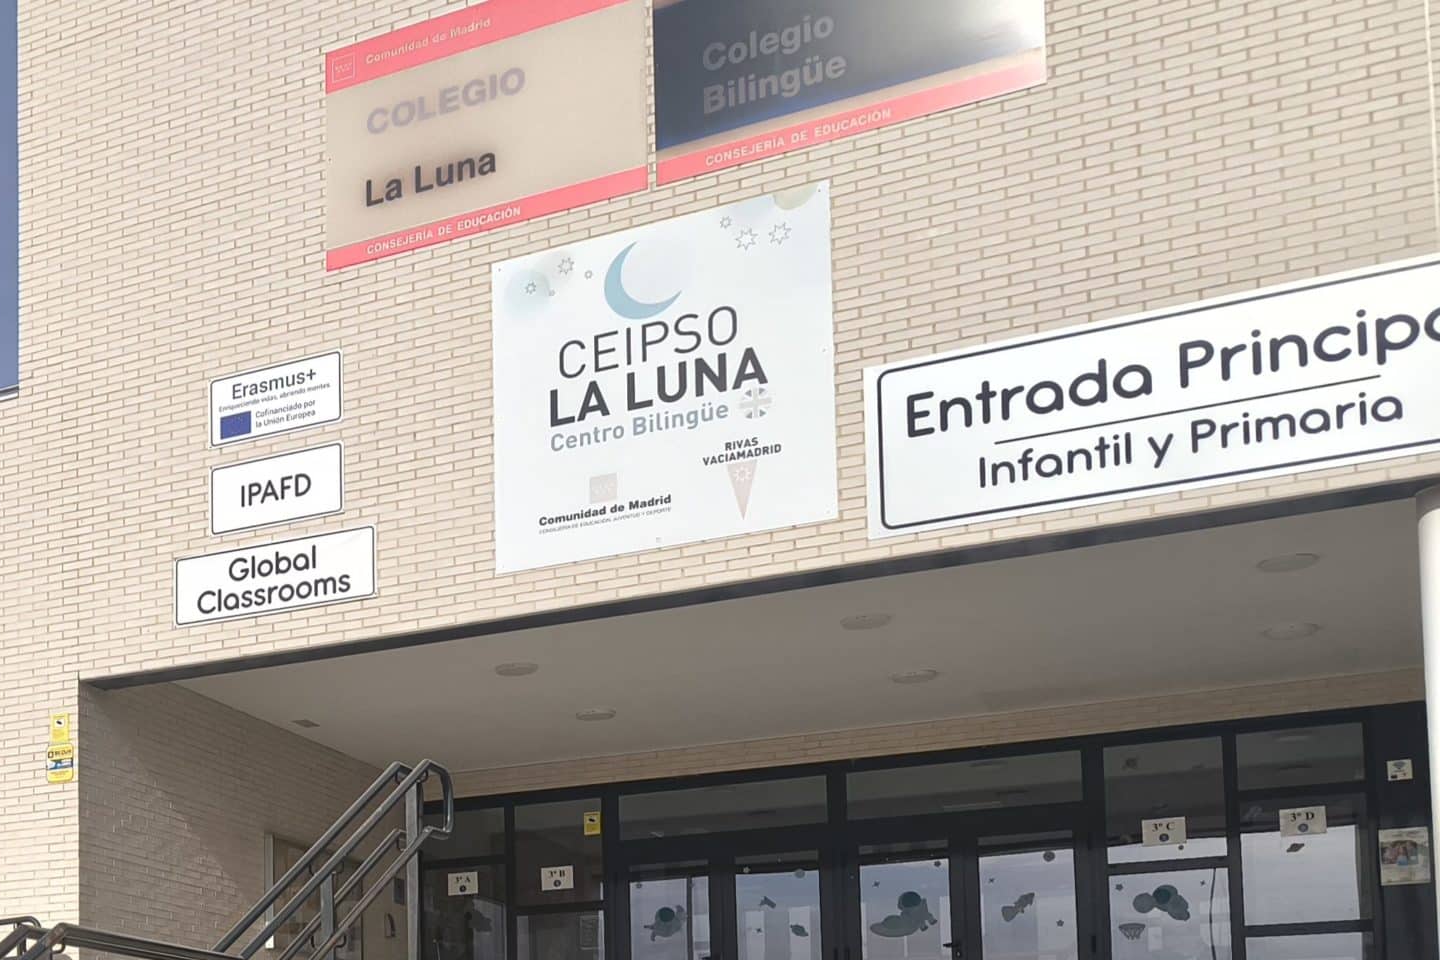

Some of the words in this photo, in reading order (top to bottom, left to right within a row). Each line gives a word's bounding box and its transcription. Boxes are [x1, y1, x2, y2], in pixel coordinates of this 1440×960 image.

[365, 34, 429, 64] Comunidad
[432, 33, 447, 43] de
[450, 18, 491, 38] Madrid
[702, 15, 835, 71] Colegio
[366, 67, 526, 135] COLEGIO
[703, 55, 848, 115] Bilingüe
[791, 130, 809, 144] DE
[365, 177, 403, 207] La
[414, 151, 497, 194] Luna
[438, 223, 452, 237] DE
[457, 206, 521, 231] EDUCACIÓN
[559, 305, 738, 379] CEIPSO
[232, 368, 317, 400] Erasmus+
[279, 387, 306, 398] abriendo
[307, 382, 331, 392] mentes
[549, 379, 611, 428] LA
[626, 346, 769, 412] LUNA
[906, 357, 1154, 439] Entrada
[255, 400, 302, 418] Cofinanciado
[303, 399, 316, 410] por
[255, 420, 262, 428] la
[263, 415, 285, 427] Unión
[286, 409, 316, 422] Europea
[550, 423, 625, 452] Centro
[632, 402, 730, 437] Bilingüe
[702, 443, 783, 467] VACIAMADRID
[724, 436, 759, 452] RIVAS
[978, 432, 1133, 488] Infantil
[1147, 432, 1175, 469] y
[1191, 391, 1404, 453] Primaria
[240, 473, 312, 508] IPAFD
[538, 500, 607, 527] Comunidad
[610, 503, 626, 514] de
[628, 494, 672, 511] Madrid
[228, 545, 317, 582] Global
[197, 573, 351, 614] Classrooms
[1305, 811, 1315, 821] D
